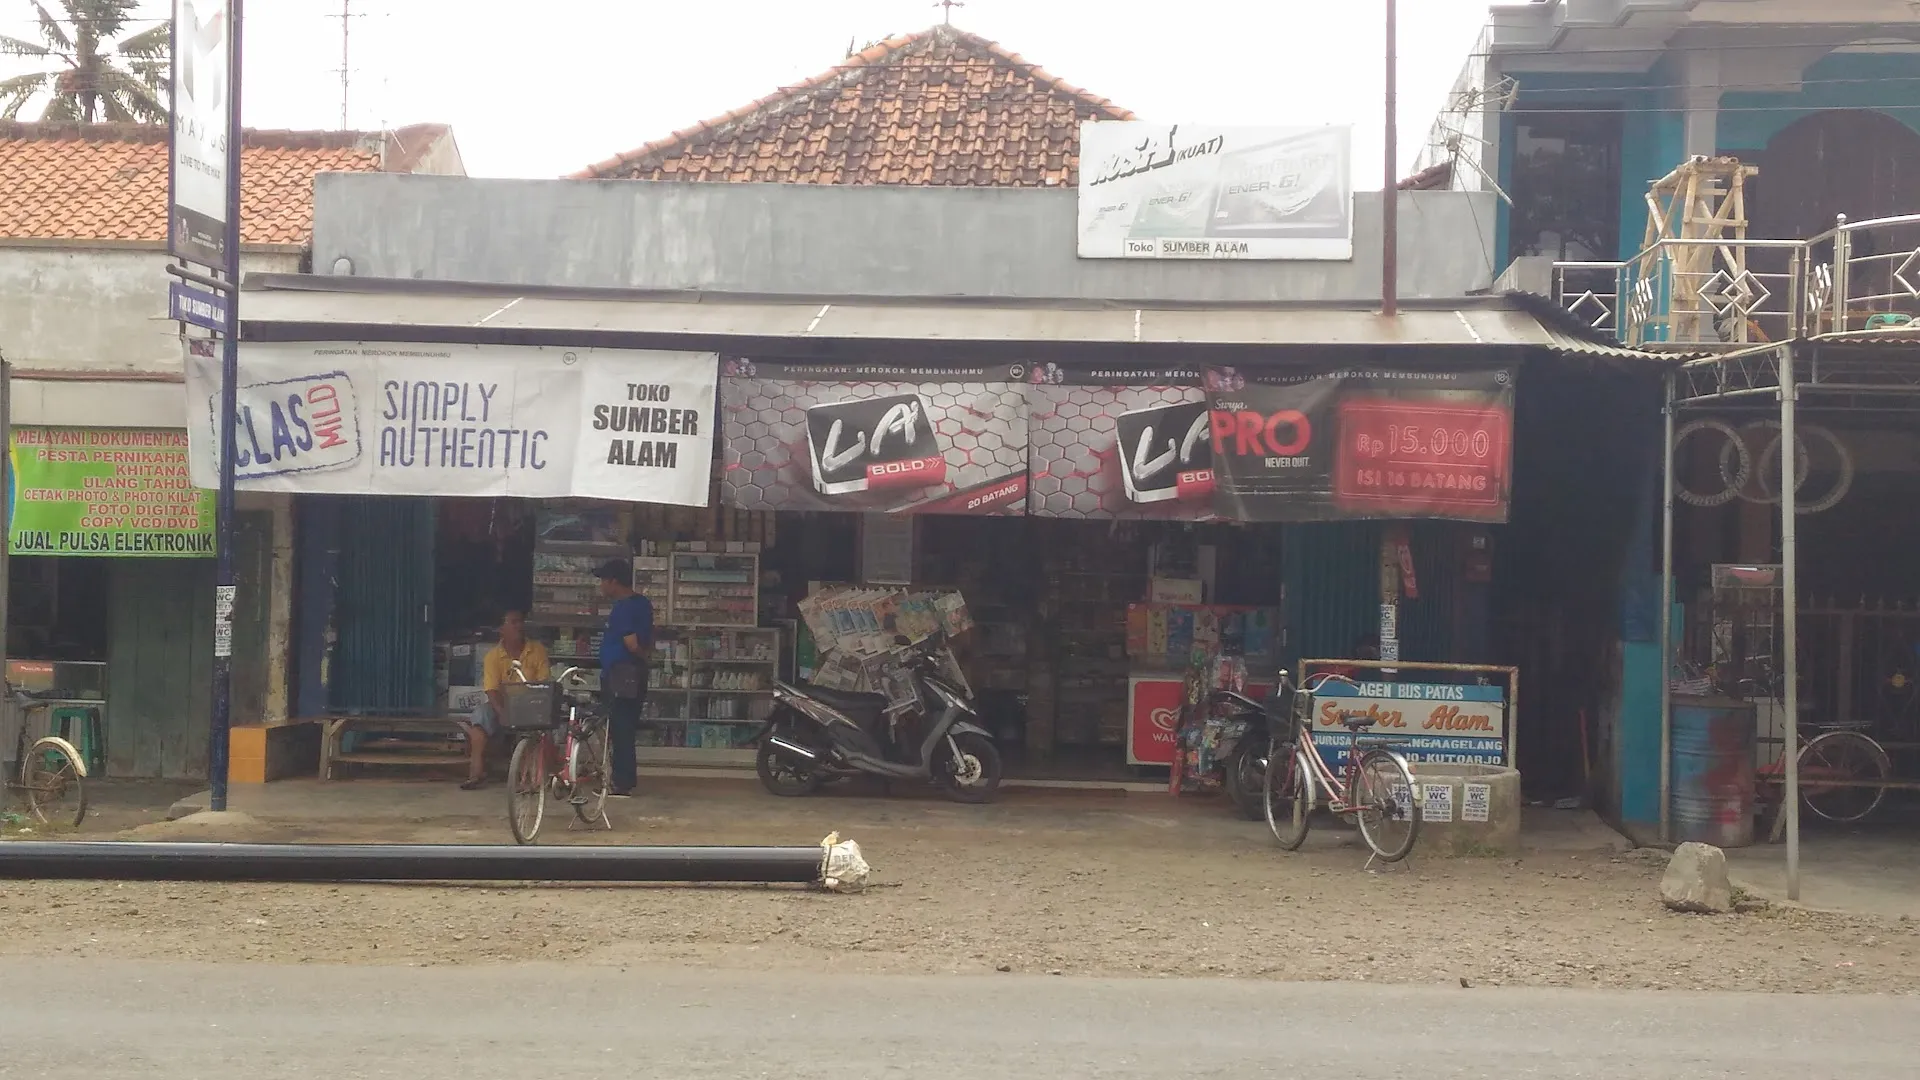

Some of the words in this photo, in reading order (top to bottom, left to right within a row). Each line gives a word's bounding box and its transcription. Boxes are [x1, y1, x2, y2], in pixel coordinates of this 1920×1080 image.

[1177, 135, 1223, 162] (KUAT)
[1129, 242, 1153, 252] Toko
[1163, 242, 1210, 253] SUMBER
[1214, 242, 1249, 253] ALAM
[910, 367, 984, 375] MEMBUNUHMU
[1164, 370, 1200, 378] MEROK
[1328, 371, 1379, 379] MEROKOK
[383, 380, 498, 422] SIMPLY
[627, 383, 670, 402] TOKO
[306, 384, 348, 449] MILD
[592, 404, 699, 436] SUMBER
[16, 431, 85, 445] MELAYANI
[90, 431, 189, 446] DOKUMENTAS
[1209, 410, 1311, 456] PRO
[1358, 433, 1384, 458] Rp
[1389, 424, 1489, 458] 15.000
[38, 450, 88, 462] PESTA
[93, 451, 188, 463] PERNIKAHA
[380, 426, 548, 470] AUTHENTIC
[607, 439, 677, 468] ALAM
[116, 465, 190, 476] KHITANA
[872, 459, 924, 476] BOLD
[1265, 456, 1291, 469] NEVER
[84, 478, 138, 489] ULANG
[144, 478, 193, 489] TAHU
[1358, 469, 1380, 486] ISI
[1411, 472, 1486, 491] BATANG
[24, 489, 63, 500] CETAK
[67, 489, 108, 501] PHOTO
[112, 491, 120, 501] &
[124, 491, 164, 501] PHOTO
[168, 492, 201, 502] KILAT
[967, 498, 982, 510] 20
[981, 484, 1019, 504] BATANG
[88, 504, 130, 515] FOTO
[136, 505, 199, 516] DIGITAL
[80, 517, 124, 528] COPY
[130, 518, 199, 529] VCD/DVD
[14, 531, 54, 550] JUAL
[59, 532, 110, 551] PULSA
[115, 533, 213, 551] ELEKTRONIK
[1358, 683, 1391, 697] AGEN
[1398, 684, 1421, 698] BUS
[1425, 685, 1464, 700] PATAS
[1422, 703, 1494, 732] Alam
[1152, 732, 1179, 743] WAL
[1313, 735, 1352, 745] JURUSA
